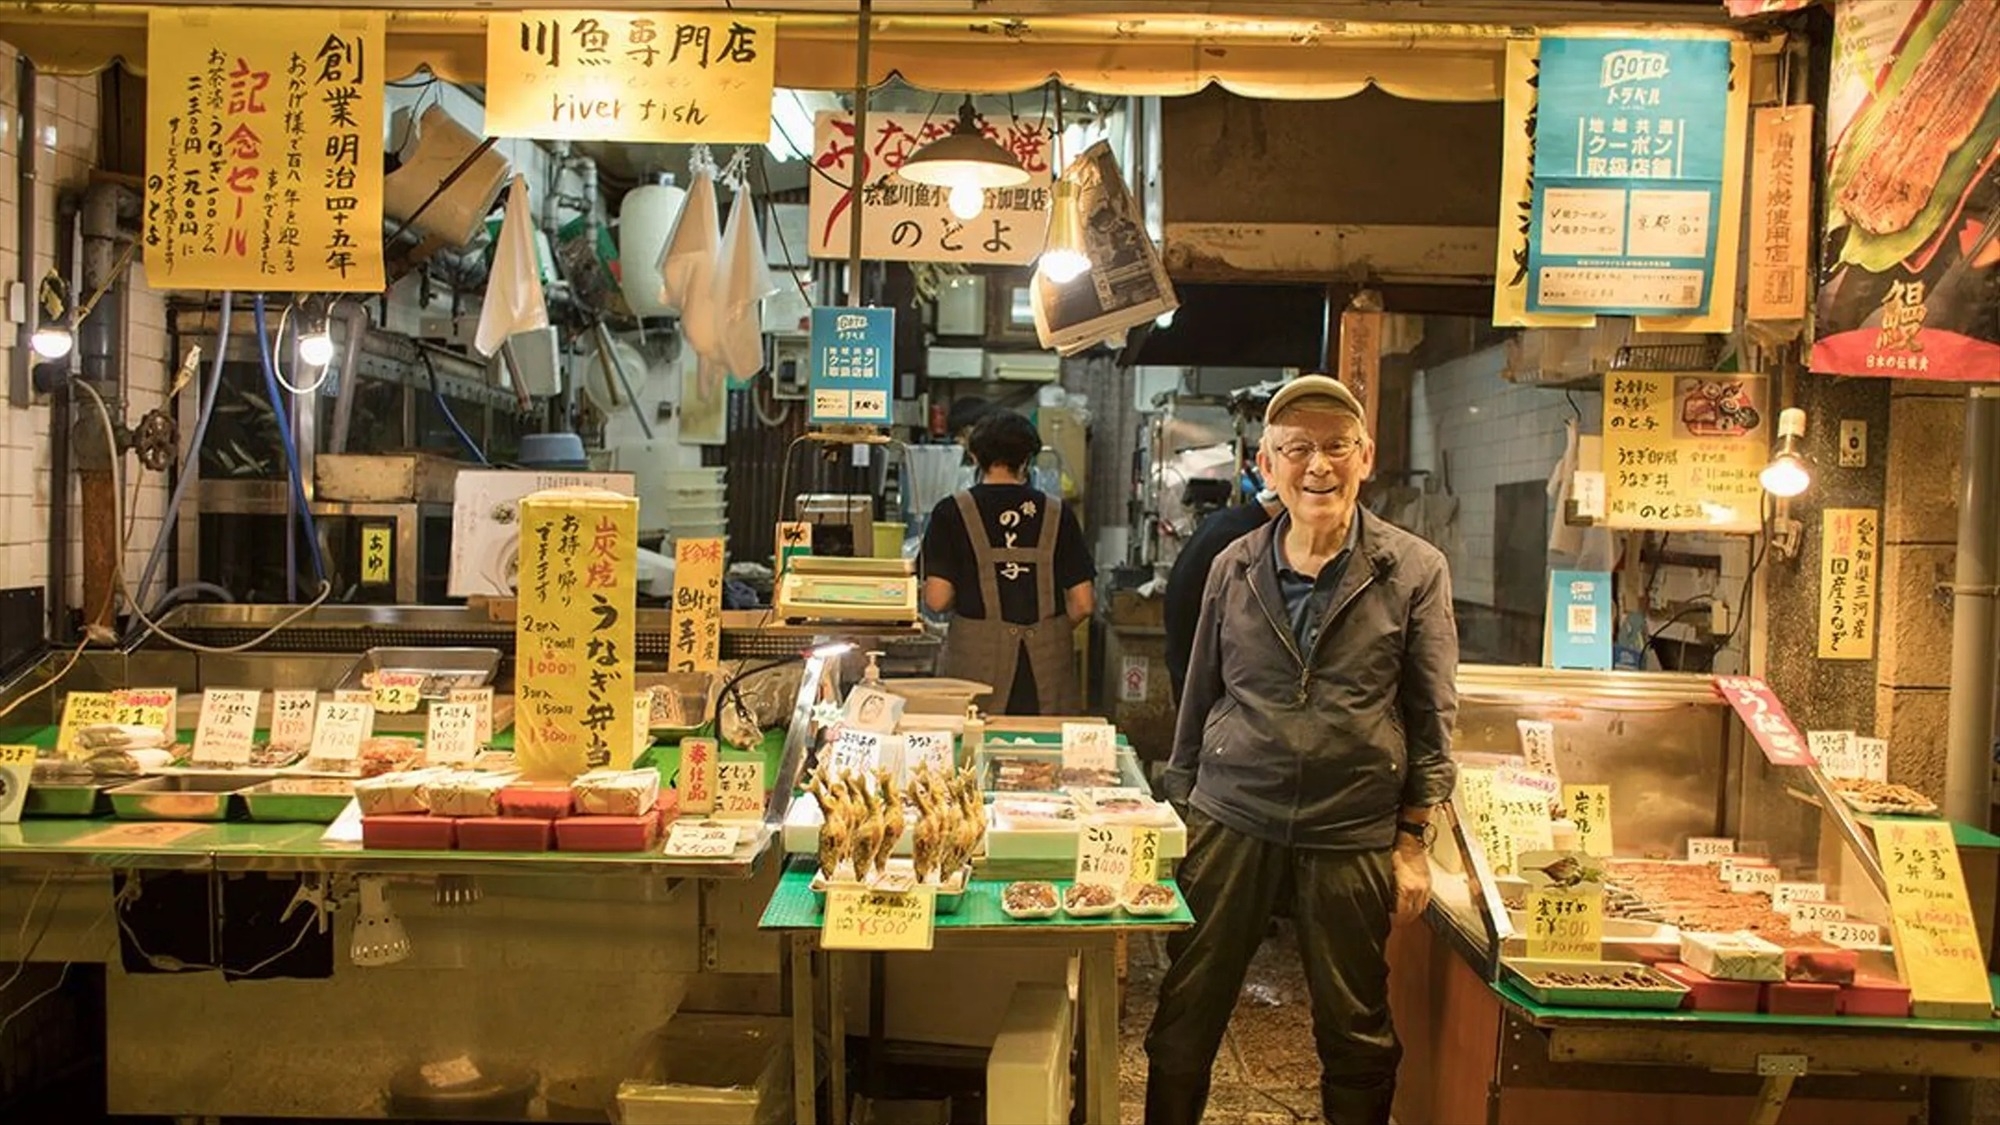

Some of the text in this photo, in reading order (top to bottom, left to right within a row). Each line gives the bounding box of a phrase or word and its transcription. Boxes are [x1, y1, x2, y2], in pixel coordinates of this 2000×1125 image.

[520, 18, 757, 69] 川魚専門店
[552, 92, 709, 125] river fish
[1606, 88, 1660, 105] トラベル
[223, 57, 271, 257] 記念セール
[314, 33, 364, 280] 創業明治四十五年
[1588, 136, 1673, 155] クーポン
[1587, 157, 1673, 176] 取扱店舗
[146, 174, 163, 246] のとよ
[891, 218, 1013, 253] のとよ
[1875, 279, 1928, 352] 鰻
[368, 534, 384, 576] あゆ
[680, 541, 722, 564] 珍味
[1851, 517, 1875, 640] 愛知県三河産
[1088, 827, 1112, 841] こい
[1840, 926, 1877, 942] 2300
